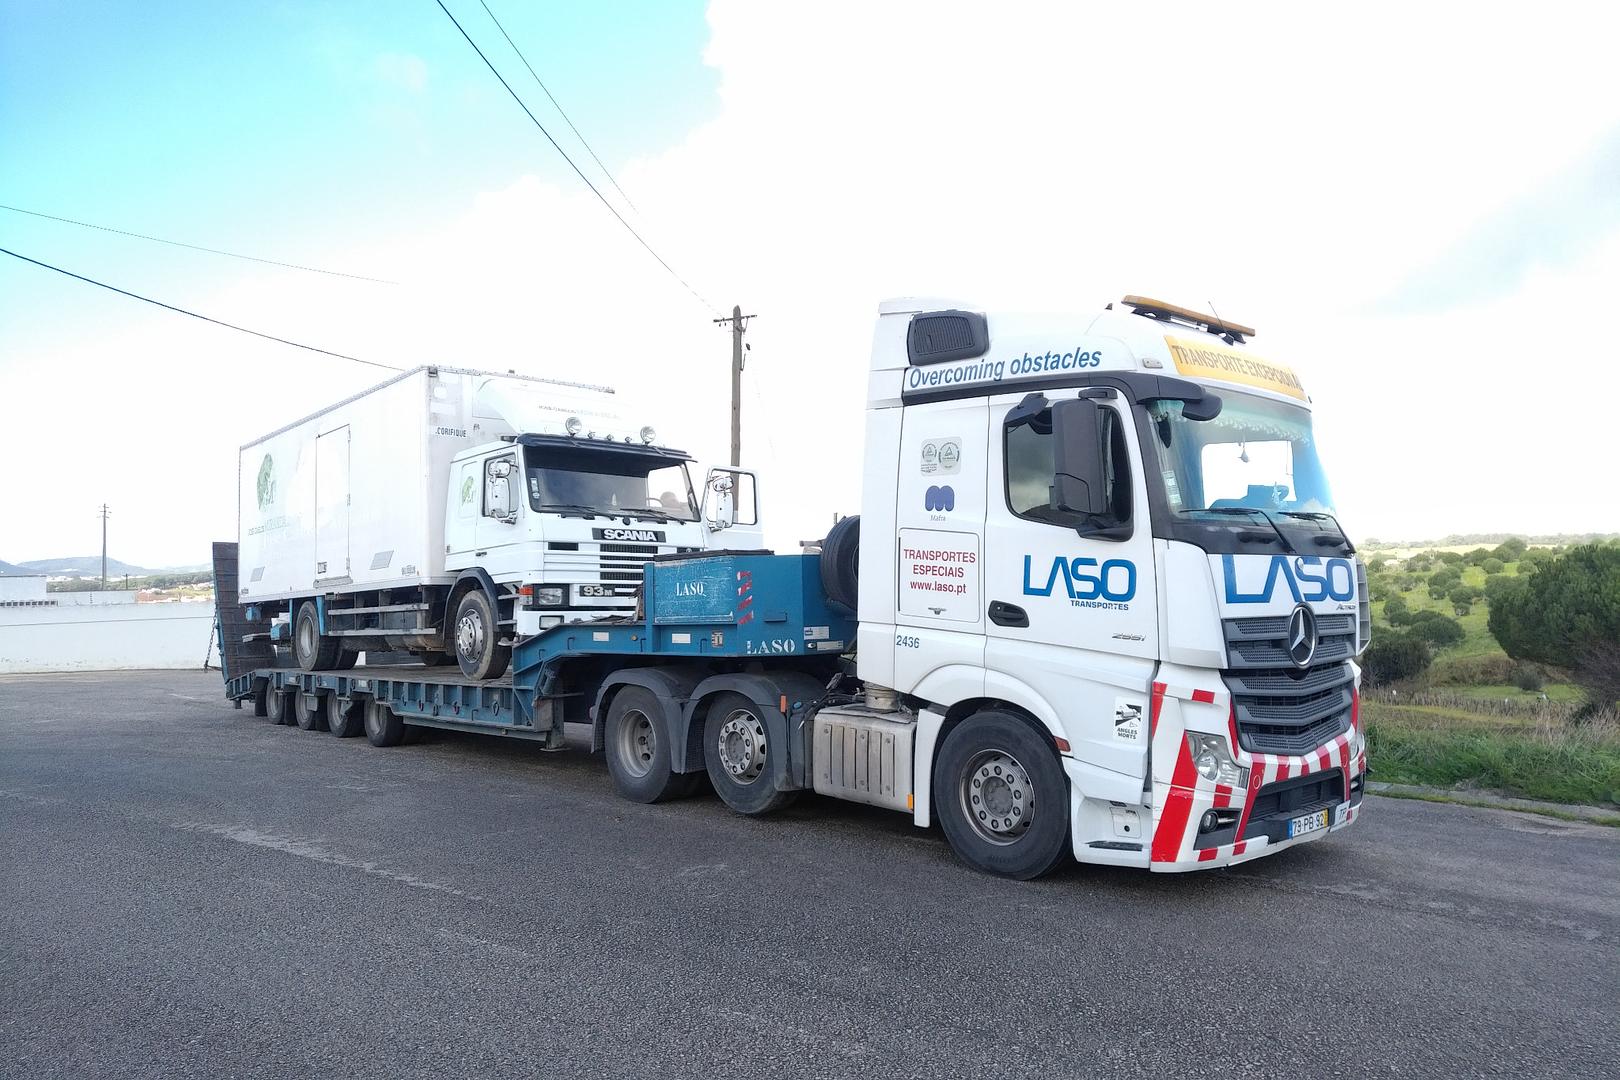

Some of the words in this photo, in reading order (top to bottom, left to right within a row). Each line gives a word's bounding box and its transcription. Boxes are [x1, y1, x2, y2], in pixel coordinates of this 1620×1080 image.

[909, 358, 1006, 389] Overcoming
[1010, 346, 1102, 379] obstacles
[1172, 345, 1248, 375] TRANSPORTE
[603, 528, 657, 541] SCANIA
[903, 548, 976, 564] TRANSPORTES
[913, 564, 964, 578] ESPECIAIS
[1023, 554, 1137, 602] LASO
[1222, 554, 1355, 605] LASO
[675, 582, 705, 597] LASO
[910, 580, 967, 595] www.laso.pt
[1070, 599, 1129, 611] TRANSPORTES
[745, 639, 796, 655] LASO
[896, 634, 920, 649] 2436
[1117, 727, 1138, 735] ANGLES
[1117, 732, 1137, 740] MORTS
